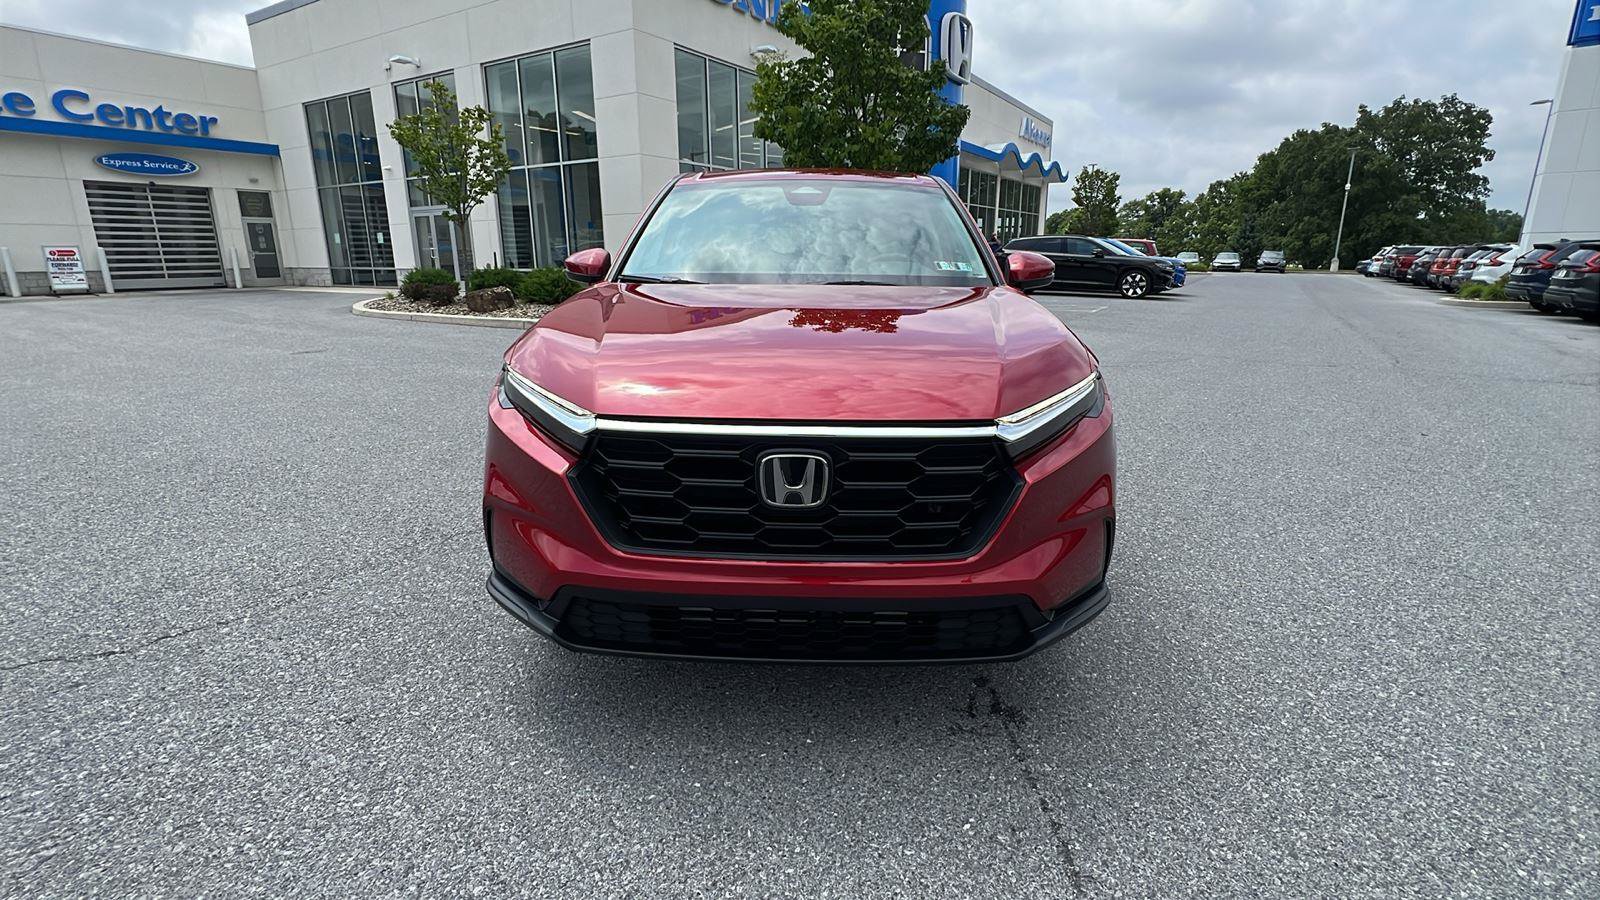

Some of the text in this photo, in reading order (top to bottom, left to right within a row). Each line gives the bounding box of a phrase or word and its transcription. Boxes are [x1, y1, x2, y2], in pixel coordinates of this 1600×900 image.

[0, 89, 218, 136] e Center
[102, 157, 179, 169] Express Service
